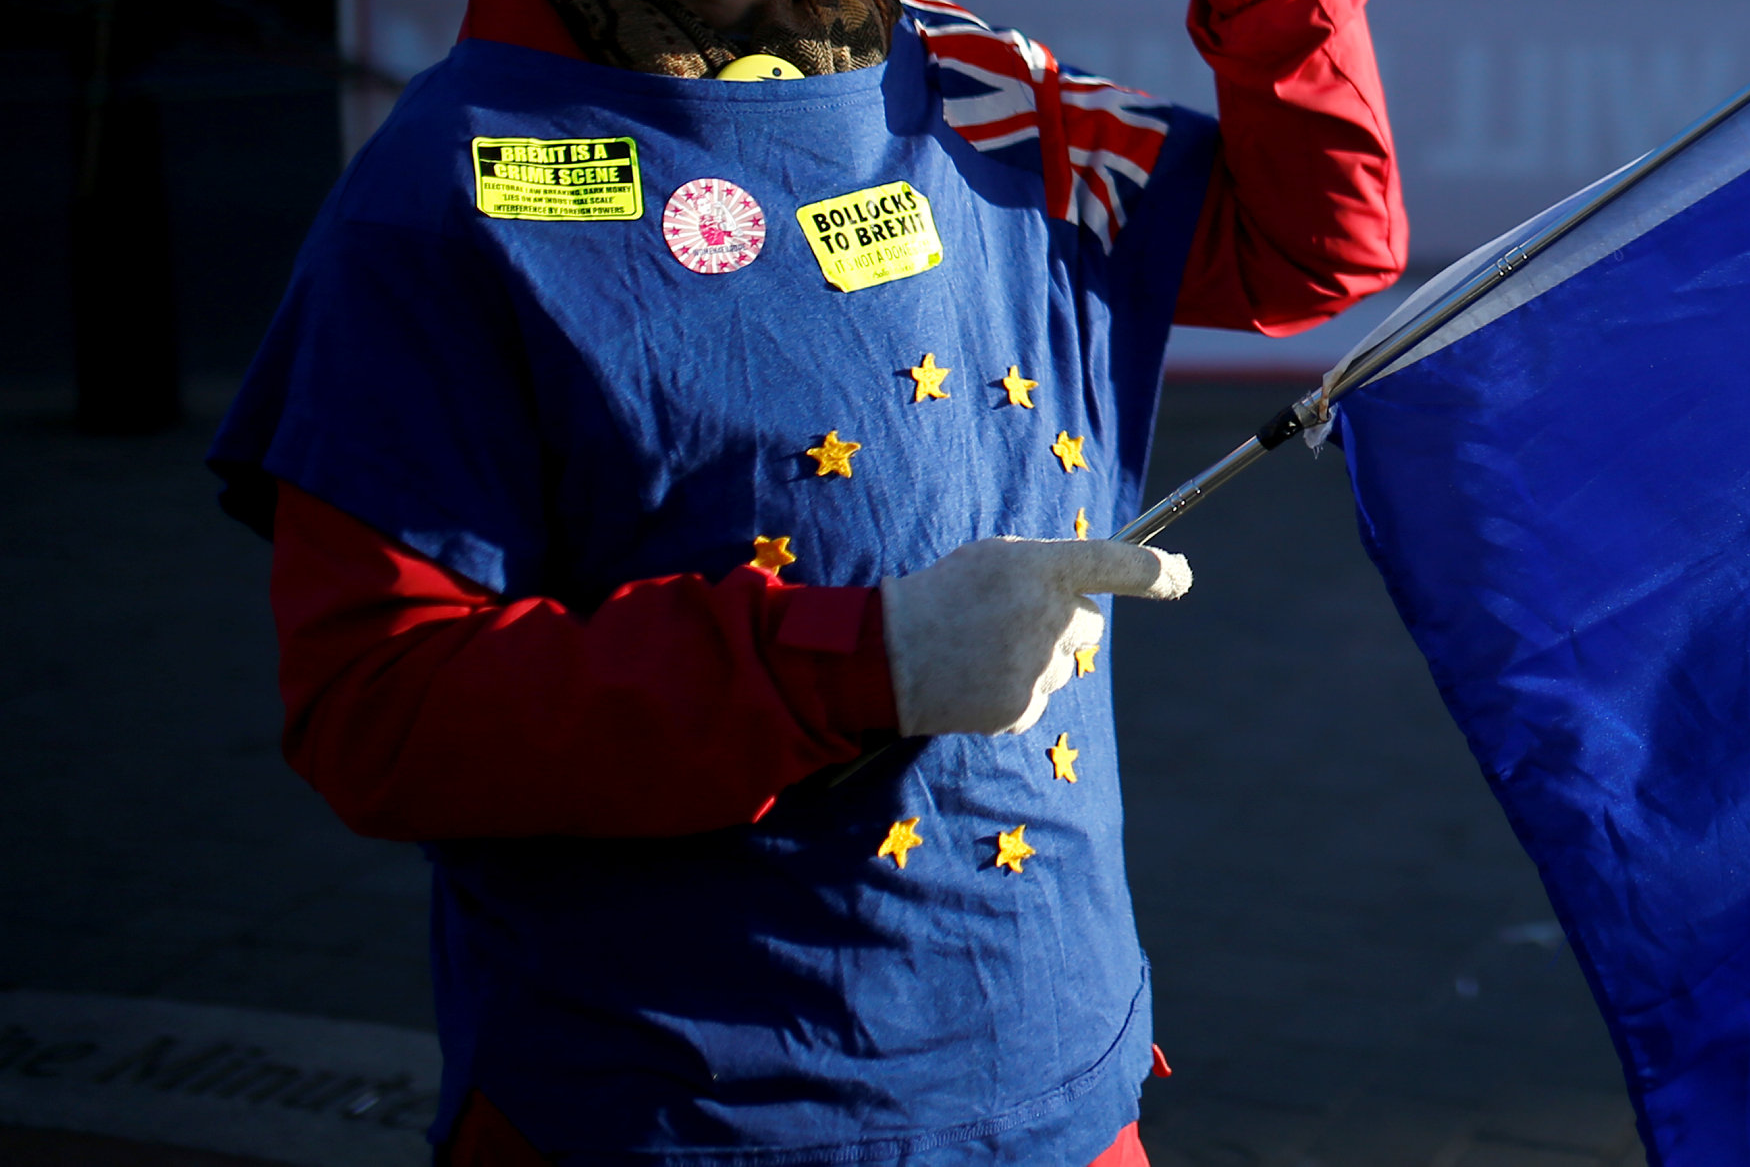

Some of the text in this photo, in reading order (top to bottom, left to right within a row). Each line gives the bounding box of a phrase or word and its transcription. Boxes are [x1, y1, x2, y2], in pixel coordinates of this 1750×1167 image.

[500, 144, 608, 164] BREXIT IS A
[493, 164, 620, 186] CRIME SCENE
[484, 182, 524, 192] ELECTORAL
[583, 186, 604, 196] DARK
[605, 185, 632, 194] MONEY
[493, 204, 547, 215] INTERFERENCE
[548, 207, 559, 215] BY
[593, 206, 625, 215] POWERS
[812, 191, 918, 233] BOLLOCKS
[820, 232, 850, 254] TO
[856, 213, 926, 247] BREXIT
[855, 254, 875, 269] NOT
[877, 251, 885, 264] A
